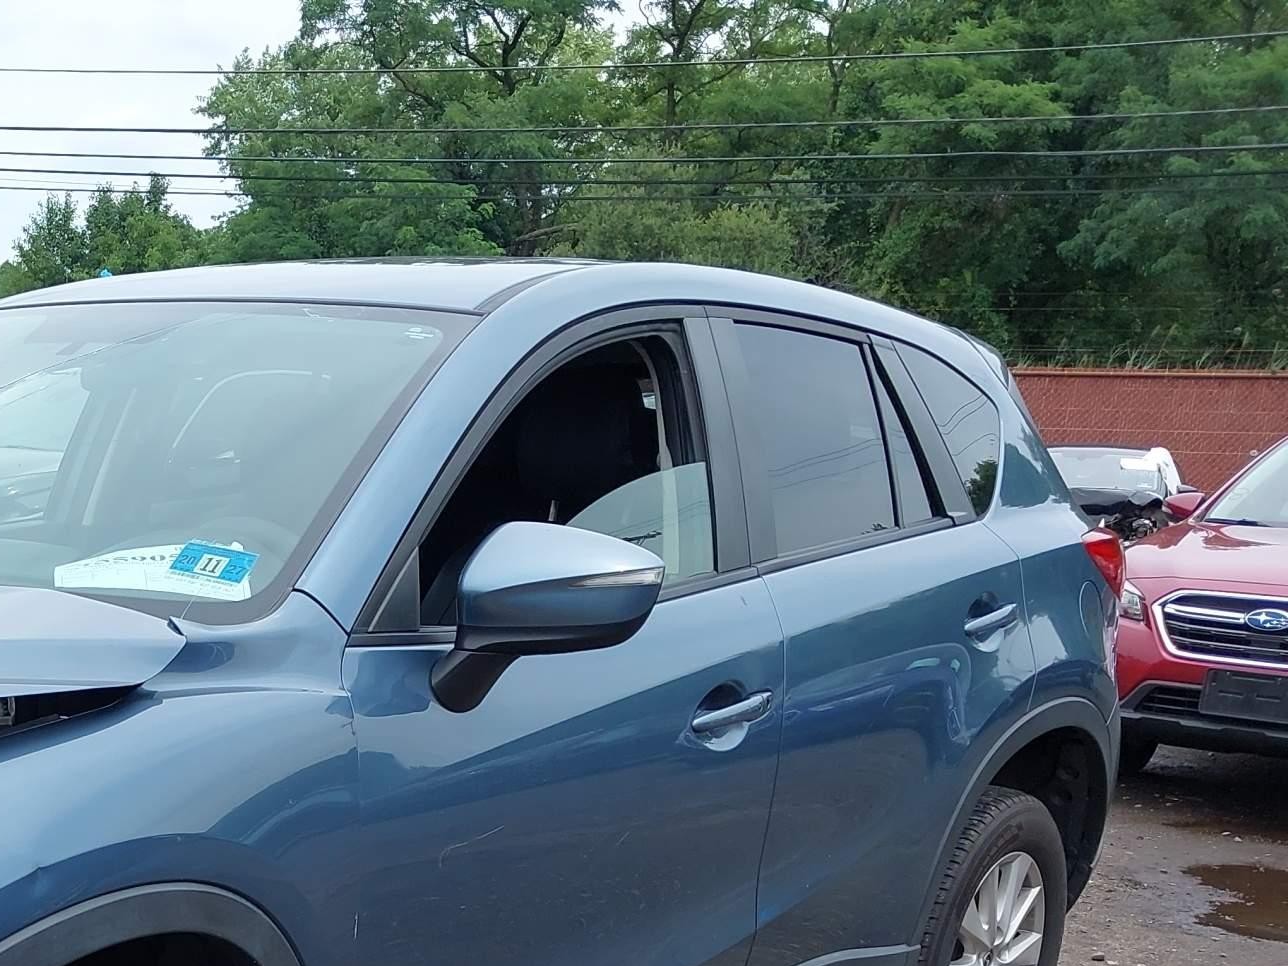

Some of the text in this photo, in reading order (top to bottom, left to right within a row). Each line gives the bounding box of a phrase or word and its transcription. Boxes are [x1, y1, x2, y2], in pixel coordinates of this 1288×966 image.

[178, 554, 247, 575] 20 11 27
